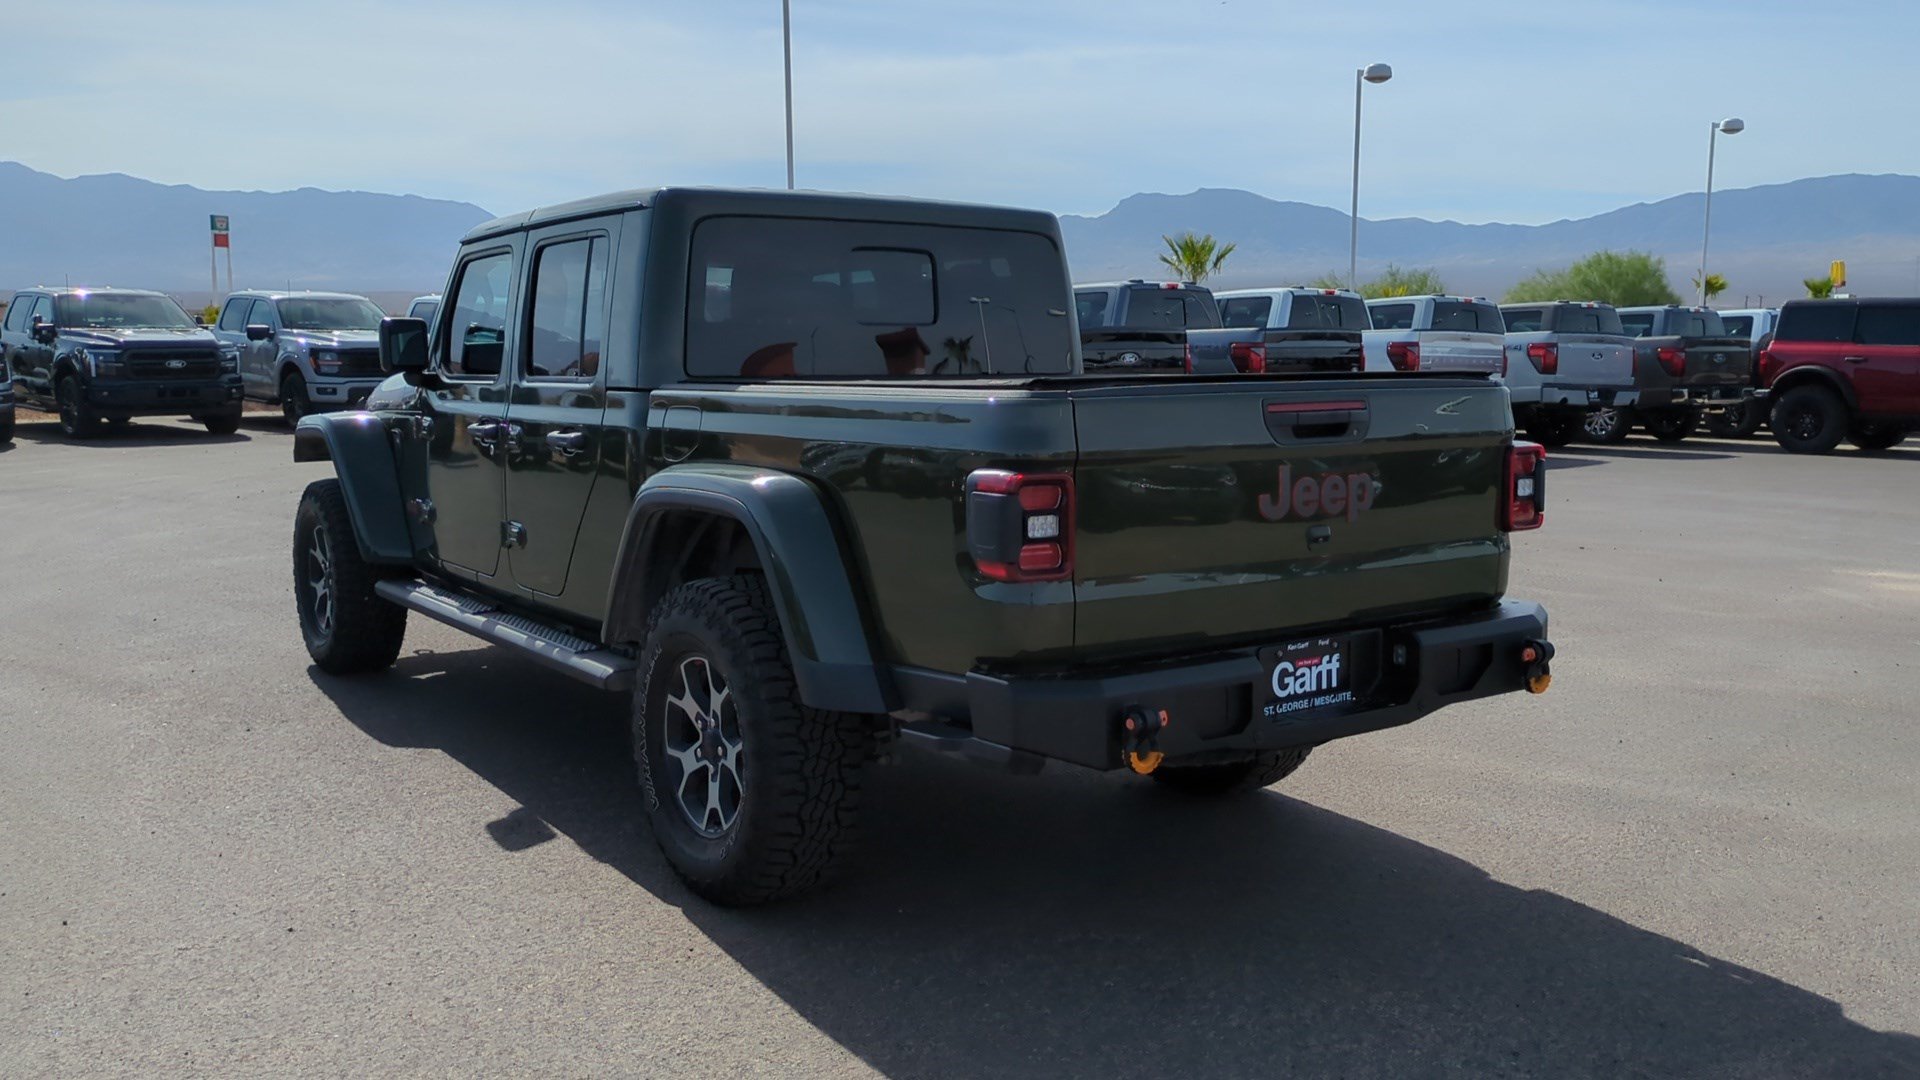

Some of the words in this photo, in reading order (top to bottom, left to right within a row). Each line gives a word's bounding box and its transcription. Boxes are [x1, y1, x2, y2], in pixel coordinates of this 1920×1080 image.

[1258, 464, 1375, 527] Jeep
[1272, 653, 1340, 698] Garff
[1263, 705, 1275, 716] ST.
[1276, 699, 1309, 714] GEORGE
[1314, 691, 1352, 706] MESQUITE
